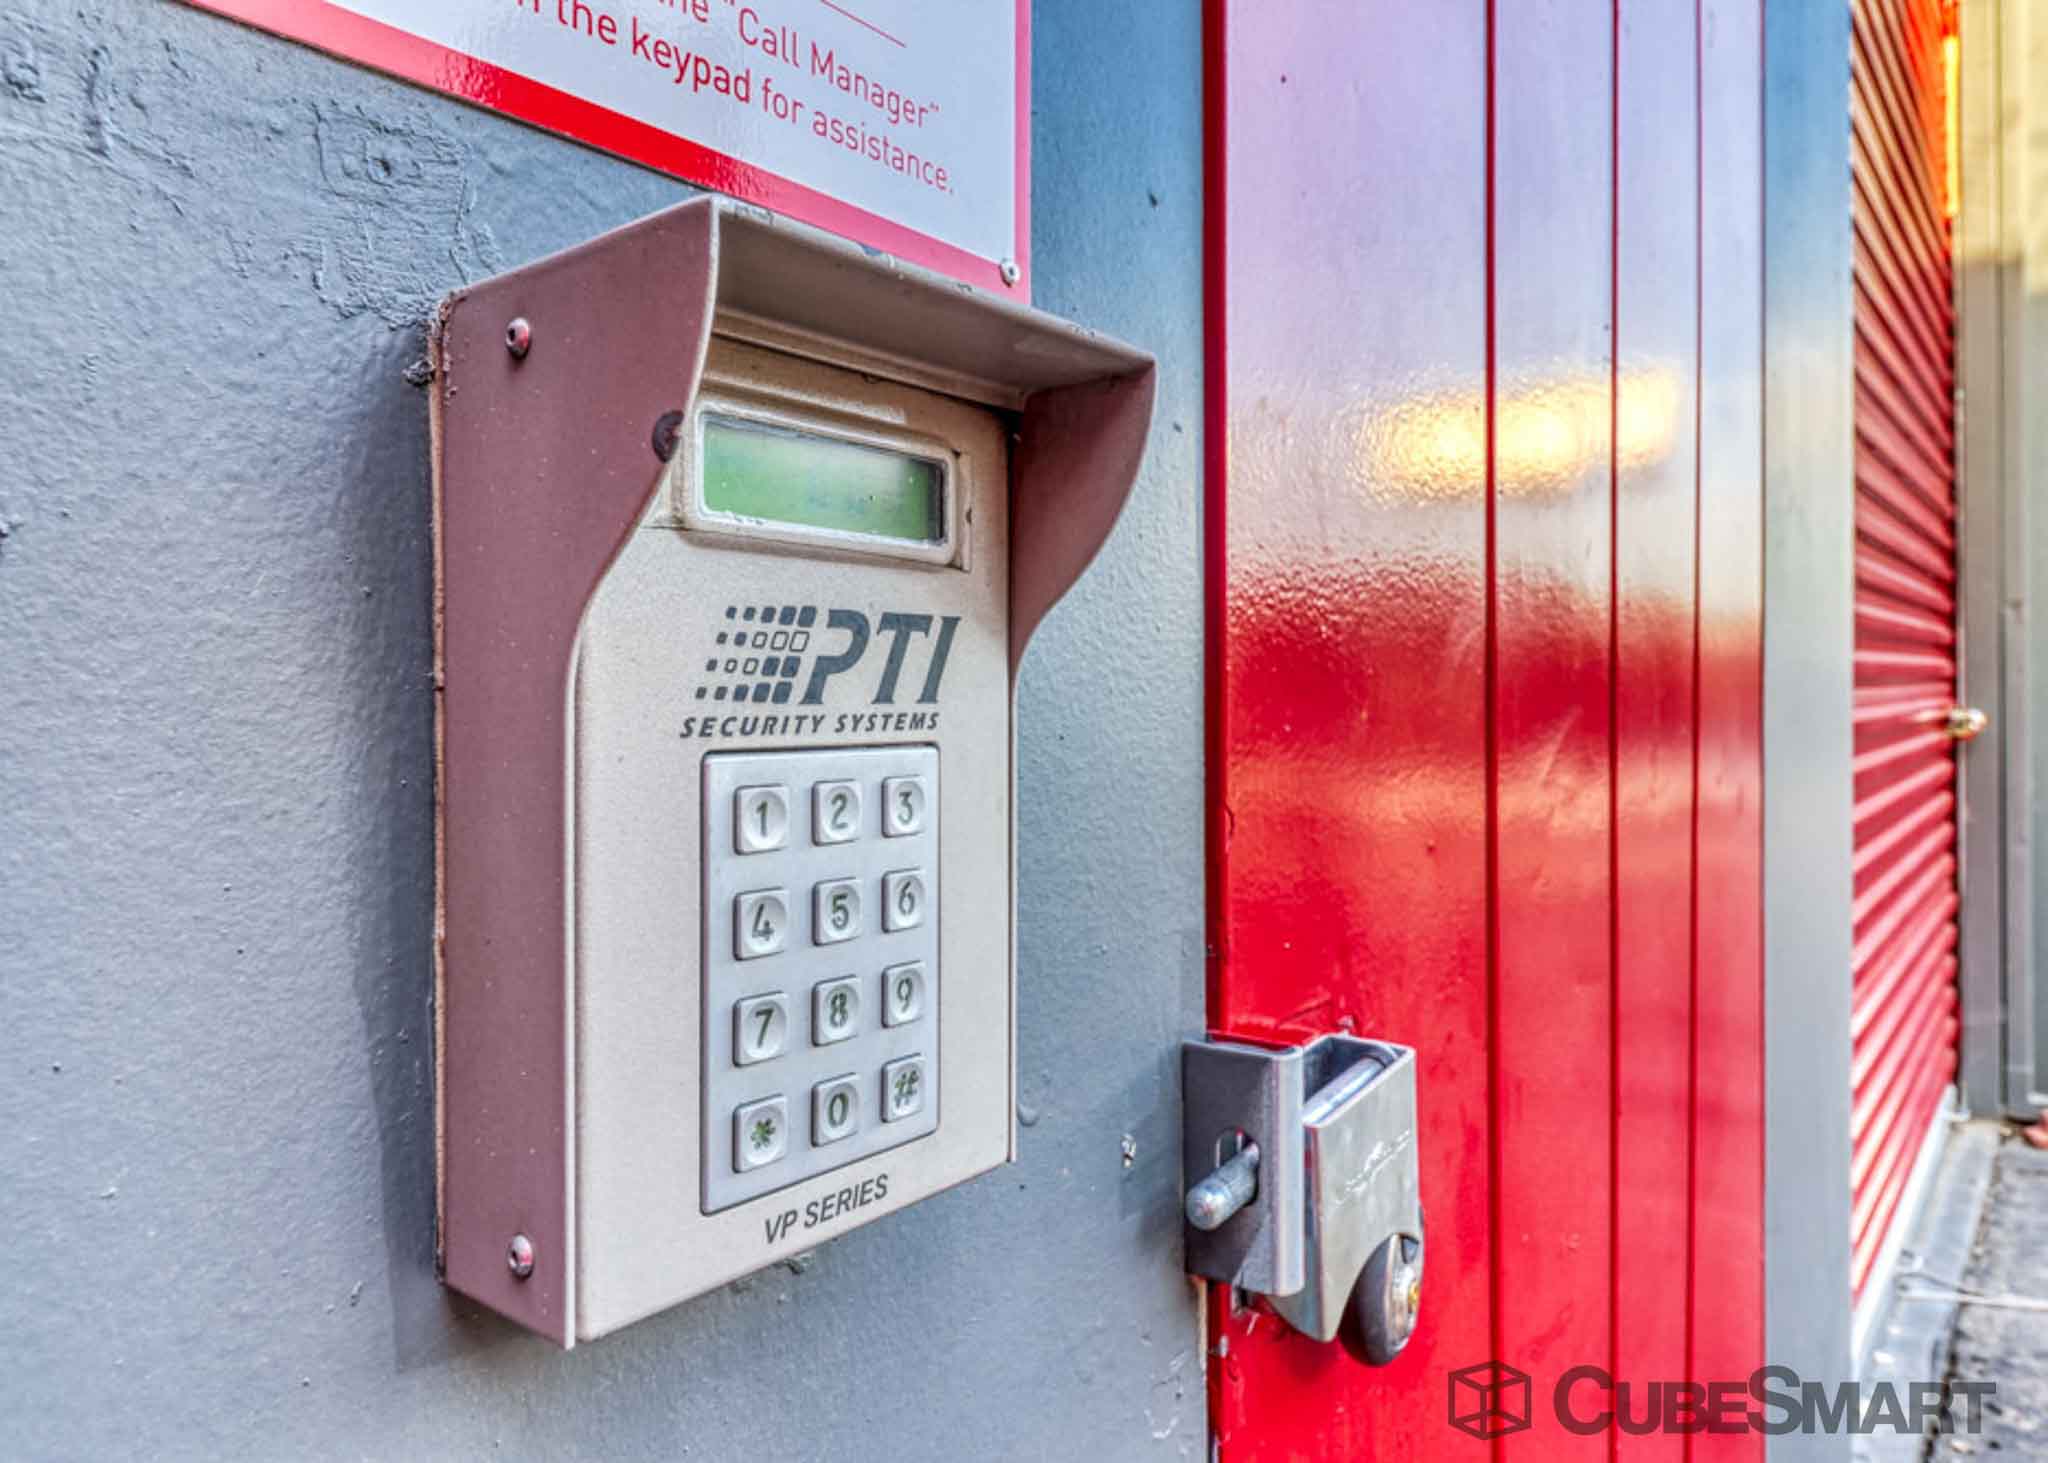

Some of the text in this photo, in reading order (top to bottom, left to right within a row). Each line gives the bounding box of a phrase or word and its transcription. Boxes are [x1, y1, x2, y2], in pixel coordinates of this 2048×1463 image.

[557, 0, 956, 195] the keypad for assistance.
[799, 608, 963, 705] PTI
[679, 712, 940, 739] SECURITY SYSTEMS
[755, 791, 914, 838] 1 2 3
[751, 881, 916, 941] 4 5 6
[754, 977, 914, 1049] 7 8 9
[827, 1092, 849, 1128] 0
[764, 1172, 889, 1244] VP SERIES
